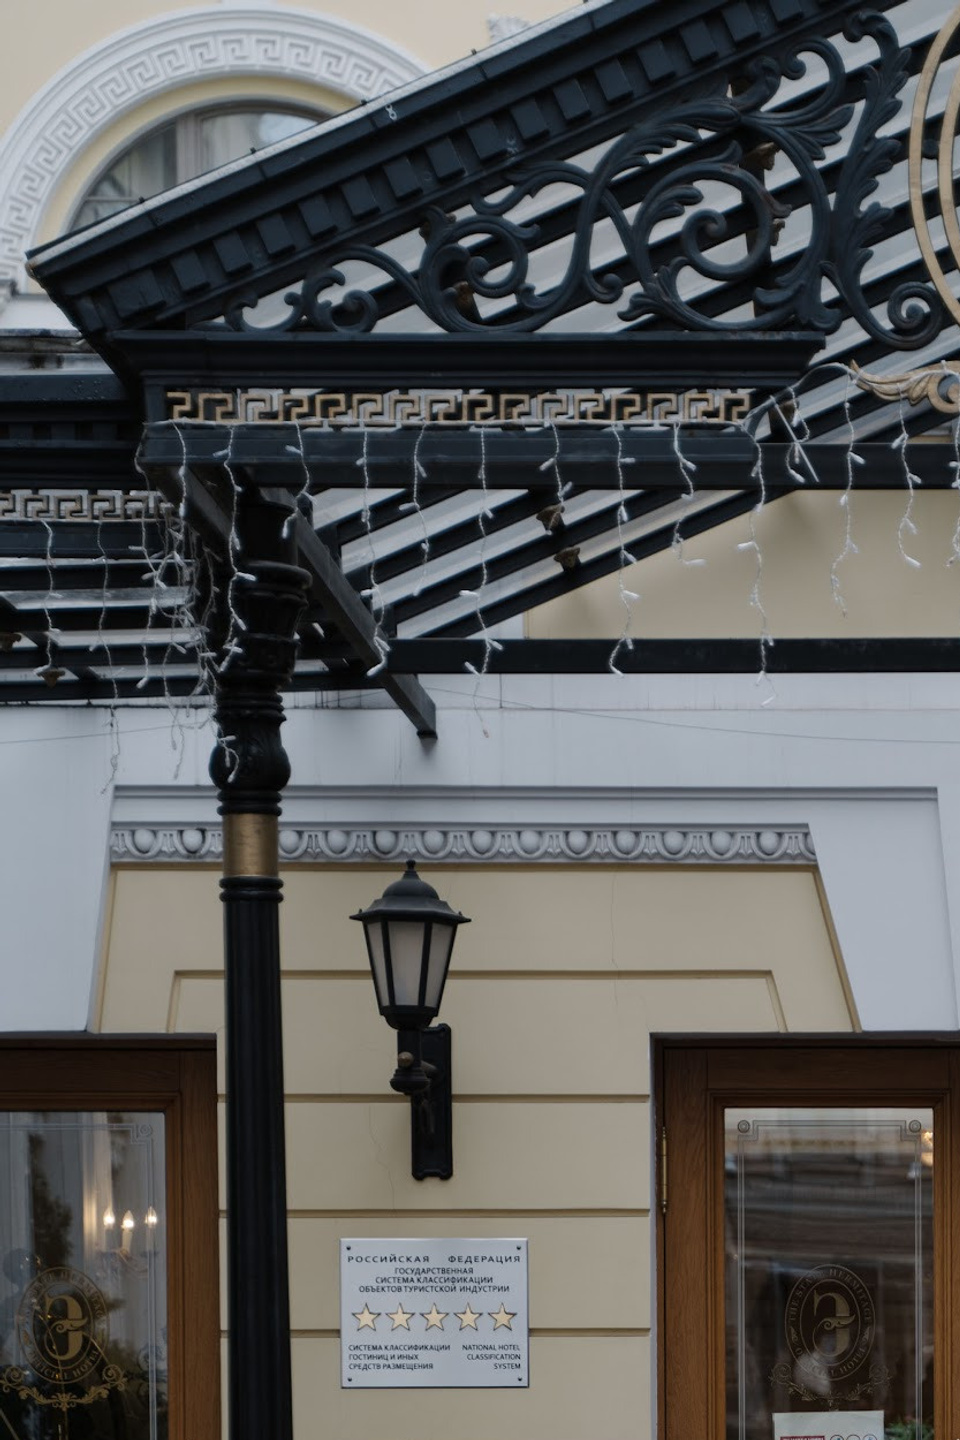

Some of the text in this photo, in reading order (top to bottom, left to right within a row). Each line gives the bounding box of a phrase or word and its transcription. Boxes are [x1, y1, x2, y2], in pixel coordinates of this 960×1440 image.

[347, 1255, 521, 1264] РОССИЙСКАЯ ФЕДЕРАЦИЯ
[394, 1267, 474, 1275] ГОСУДАРСТВЕННАЯ
[375, 1276, 493, 1285] СИСТЕМА КЛАССИФИКАЦИИ
[359, 1284, 510, 1293] ОБЪЕКТОВ ТУРИСТСКОЙ ИНДУСТРИИ
[384, 1344, 451, 1352] КЛАССИФИКАЦИИ
[349, 1354, 389, 1362] ГОСТИНИЦ
[467, 1353, 521, 1361] CLASSIFICATION
[348, 1363, 434, 1371] СРЕДСТВ РАЗМЕЩЕНИЯ
